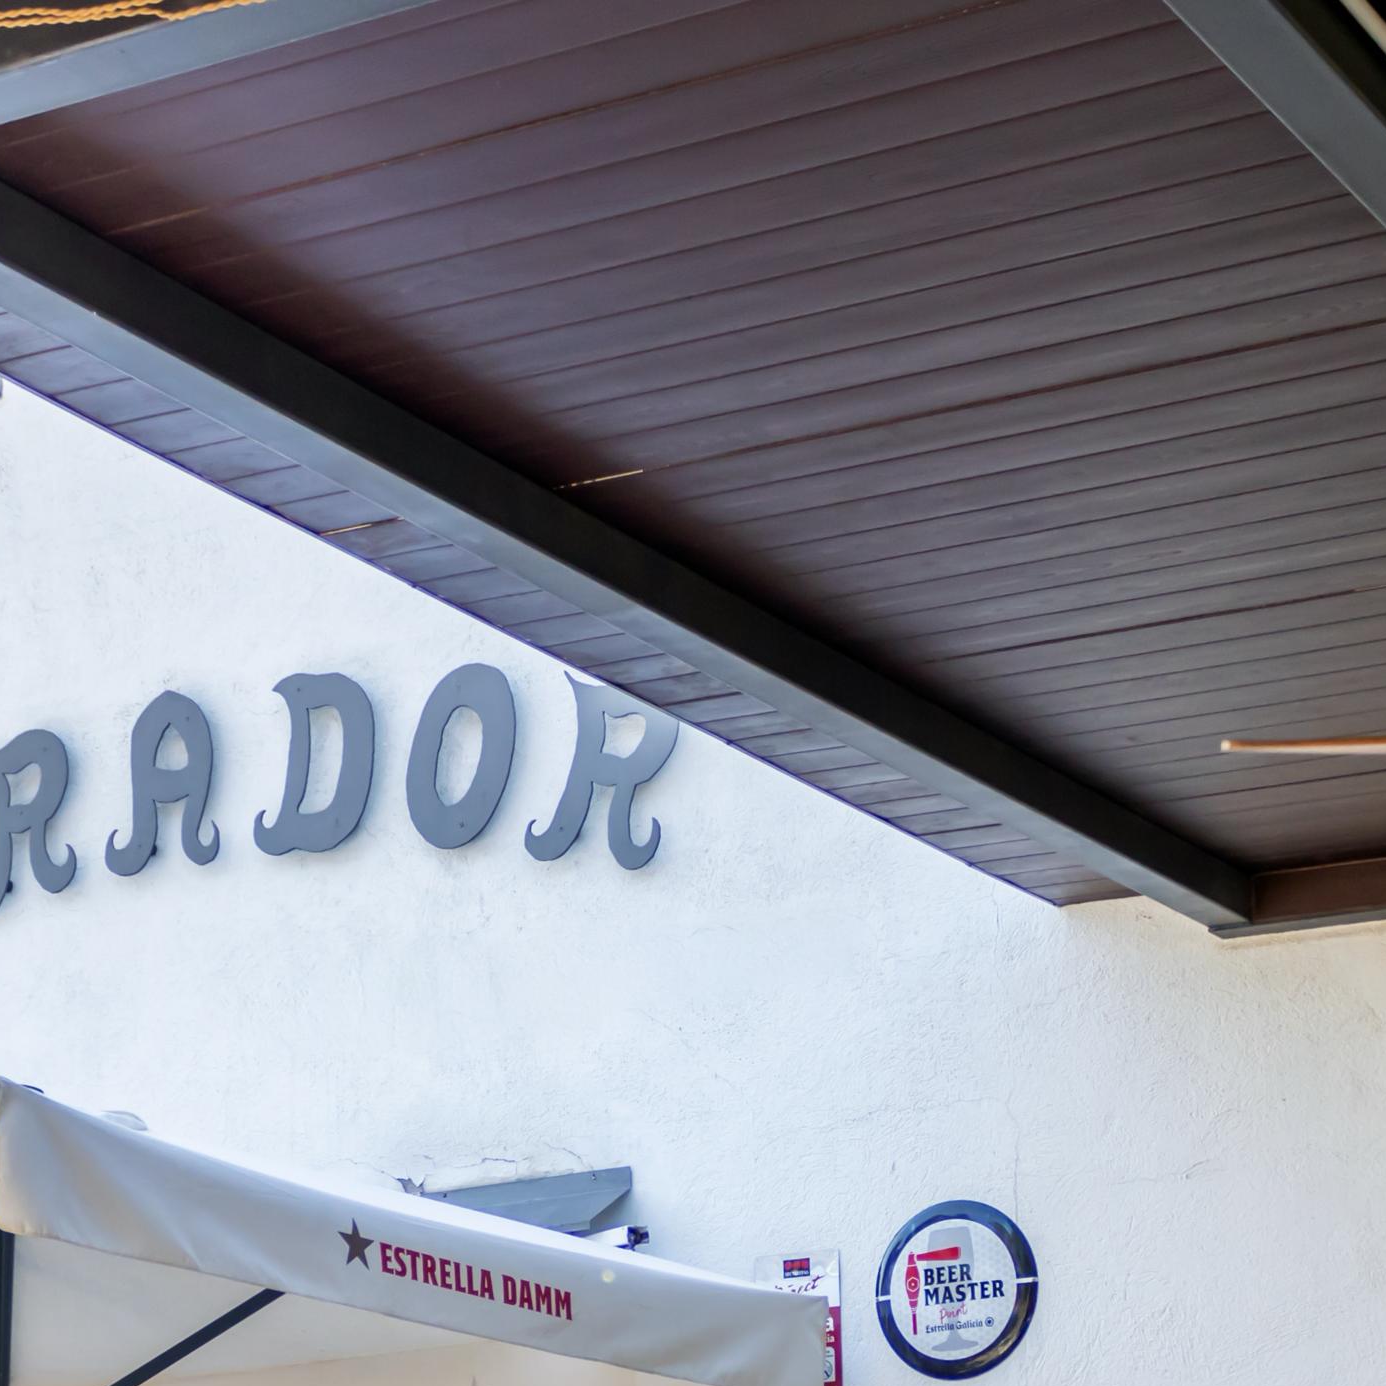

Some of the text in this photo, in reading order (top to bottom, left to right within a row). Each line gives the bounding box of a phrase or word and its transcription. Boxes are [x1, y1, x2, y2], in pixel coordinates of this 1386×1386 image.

[379, 1241, 573, 1321] ESTRELLA DAMM
[923, 1263, 973, 1286] BEER
[924, 1279, 1005, 1306] MASTER
[925, 1319, 984, 1334] Estrella Galicia
